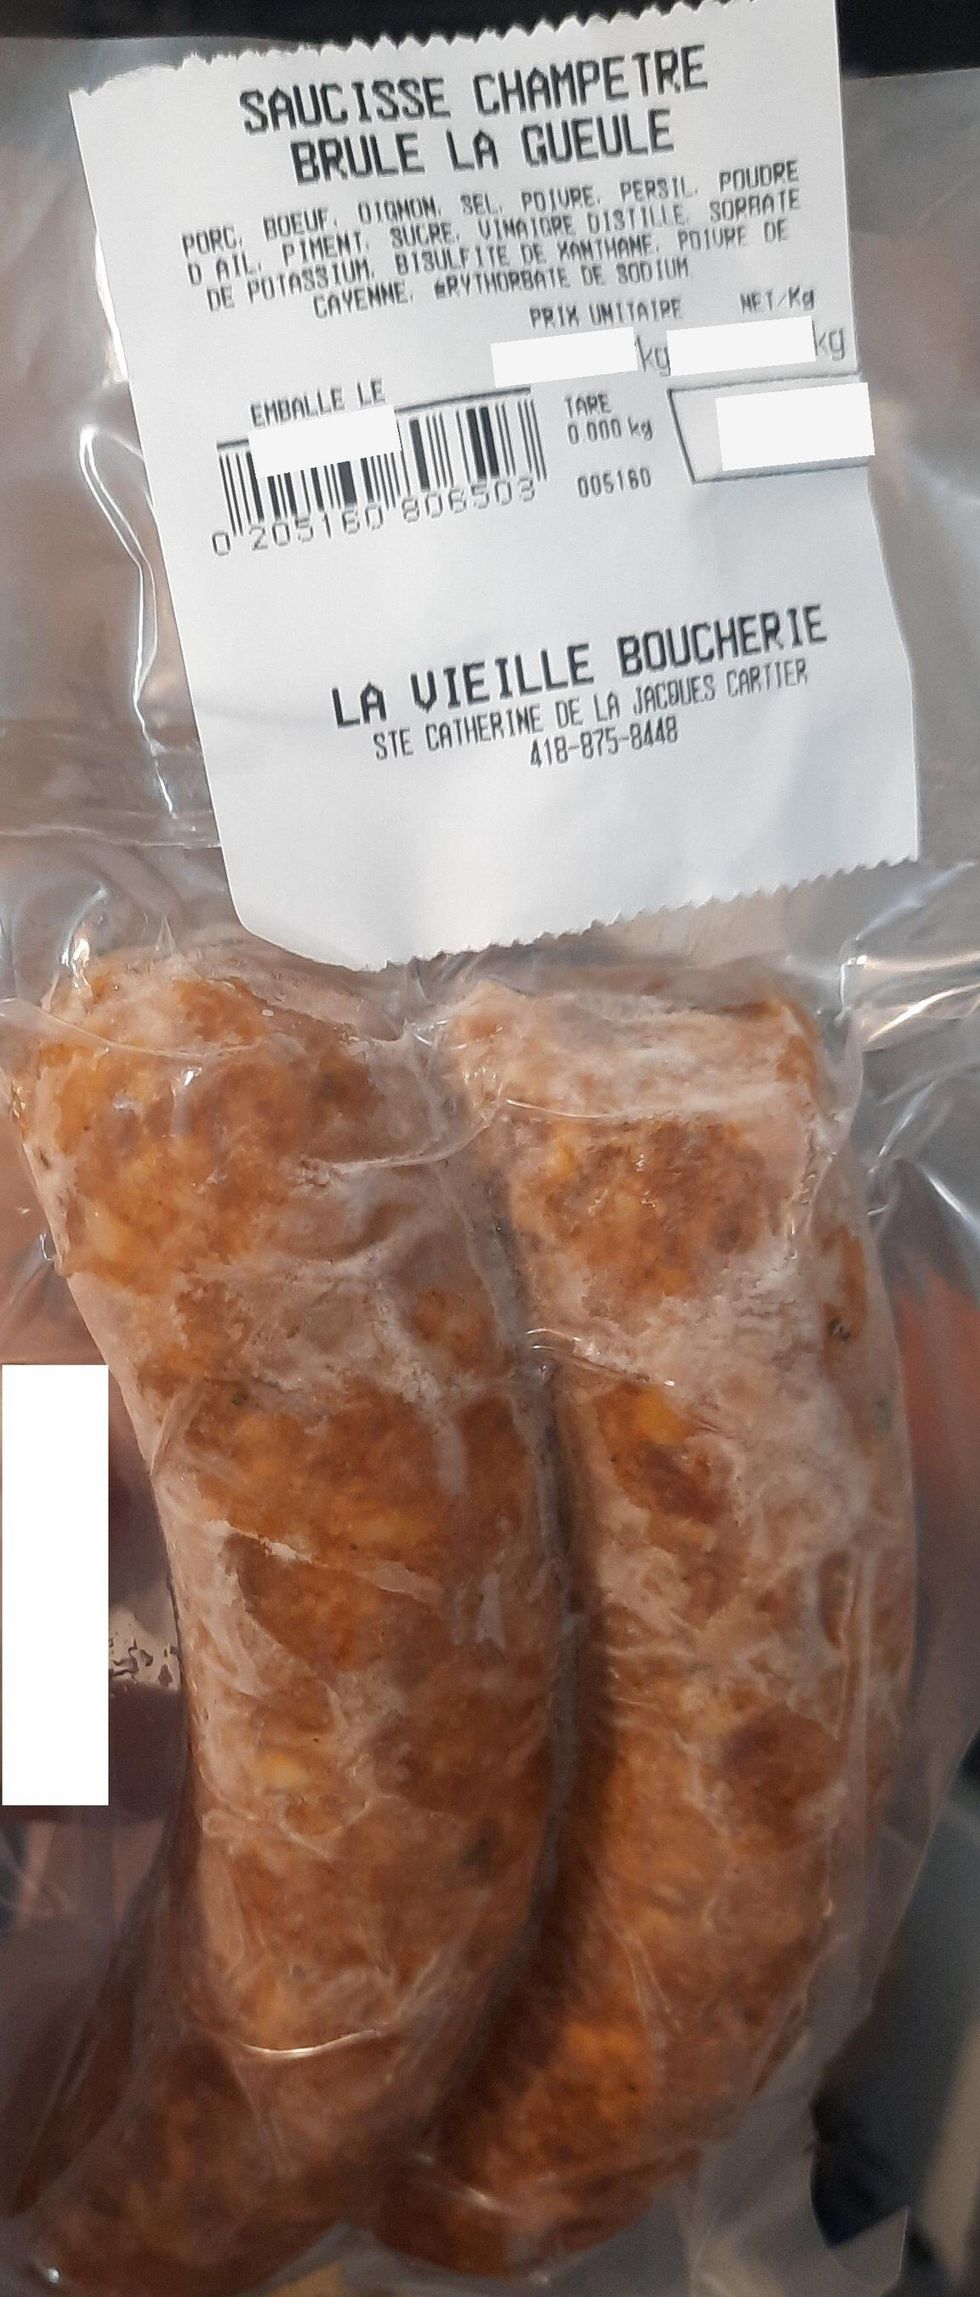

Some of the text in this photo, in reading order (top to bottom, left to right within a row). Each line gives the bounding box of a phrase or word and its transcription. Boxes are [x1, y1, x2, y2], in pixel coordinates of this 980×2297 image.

[239, 44, 707, 136] SAUCISSE CHAMPETRE
[291, 108, 674, 186] BRULE LA GUEULE
[719, 160, 799, 193] POUDRE
[477, 215, 575, 241] VINAIGRE
[709, 188, 800, 222] SORBATE
[205, 284, 235, 313] DE
[394, 244, 510, 276] BISULFITE
[520, 242, 546, 265] DE
[763, 218, 788, 243] DE
[581, 264, 606, 287] DE
[616, 256, 689, 284] SODIUM
[529, 298, 684, 329] PRIX UNITAIRE
[740, 286, 815, 313] NET/Kg
[250, 378, 386, 428] EMBALLE LE
[564, 393, 612, 418] TARE
[627, 416, 653, 441] kg
[577, 467, 651, 498] 005160
[212, 530, 231, 556] 0
[332, 604, 828, 729] LA VIEILLE BOUCHERIE
[372, 657, 808, 761] STE CATHERINE DE LA JACQUES CARTIER
[530, 715, 678, 768] 418-875-8448
